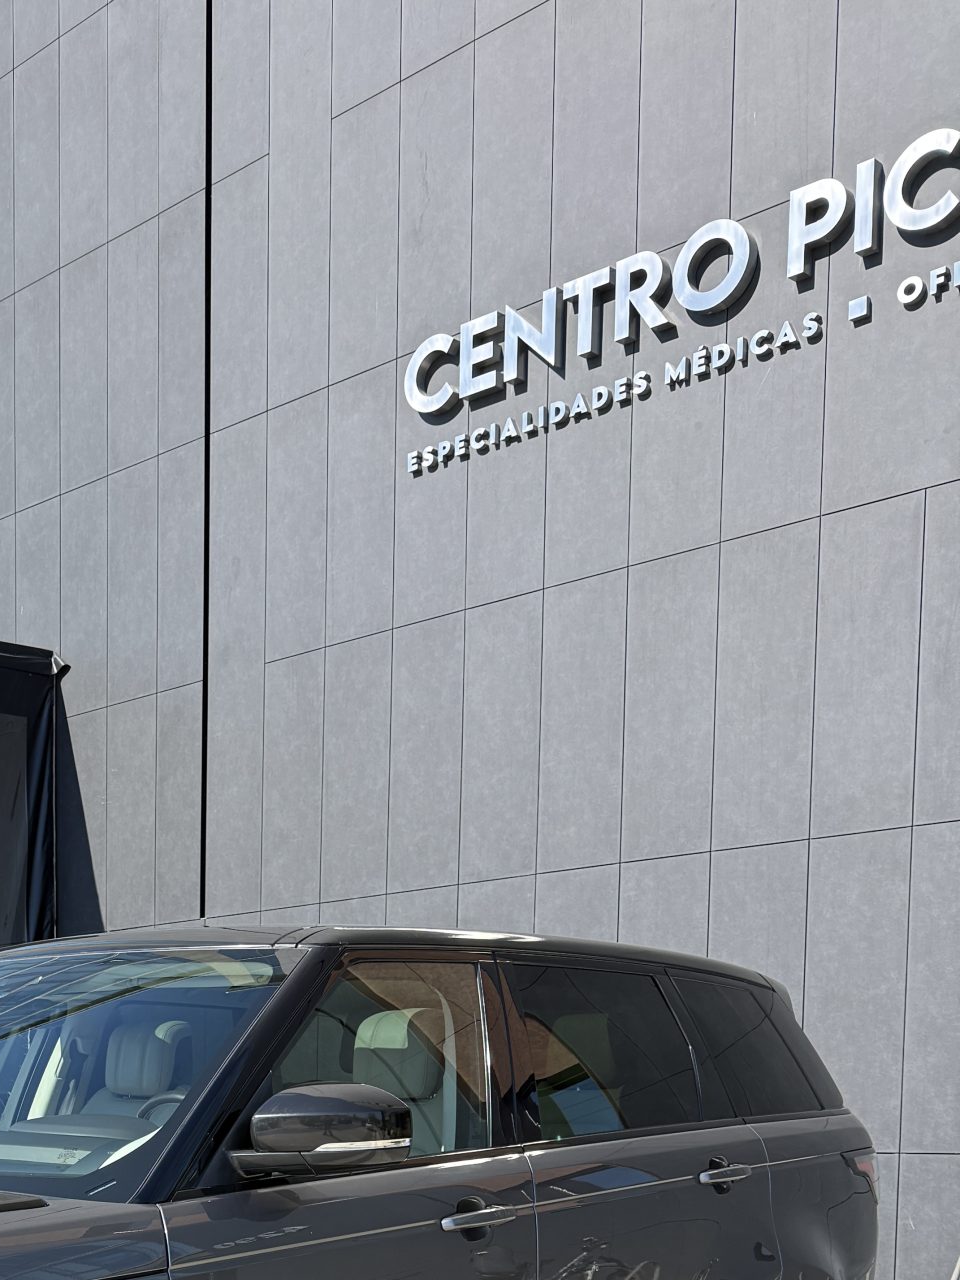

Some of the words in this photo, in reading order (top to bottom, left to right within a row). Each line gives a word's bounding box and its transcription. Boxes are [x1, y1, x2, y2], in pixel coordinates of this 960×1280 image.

[403, 218, 756, 415] CENTRO
[406, 370, 649, 475] ESPECIALIDADES
[664, 312, 824, 387] MÉDICAS
